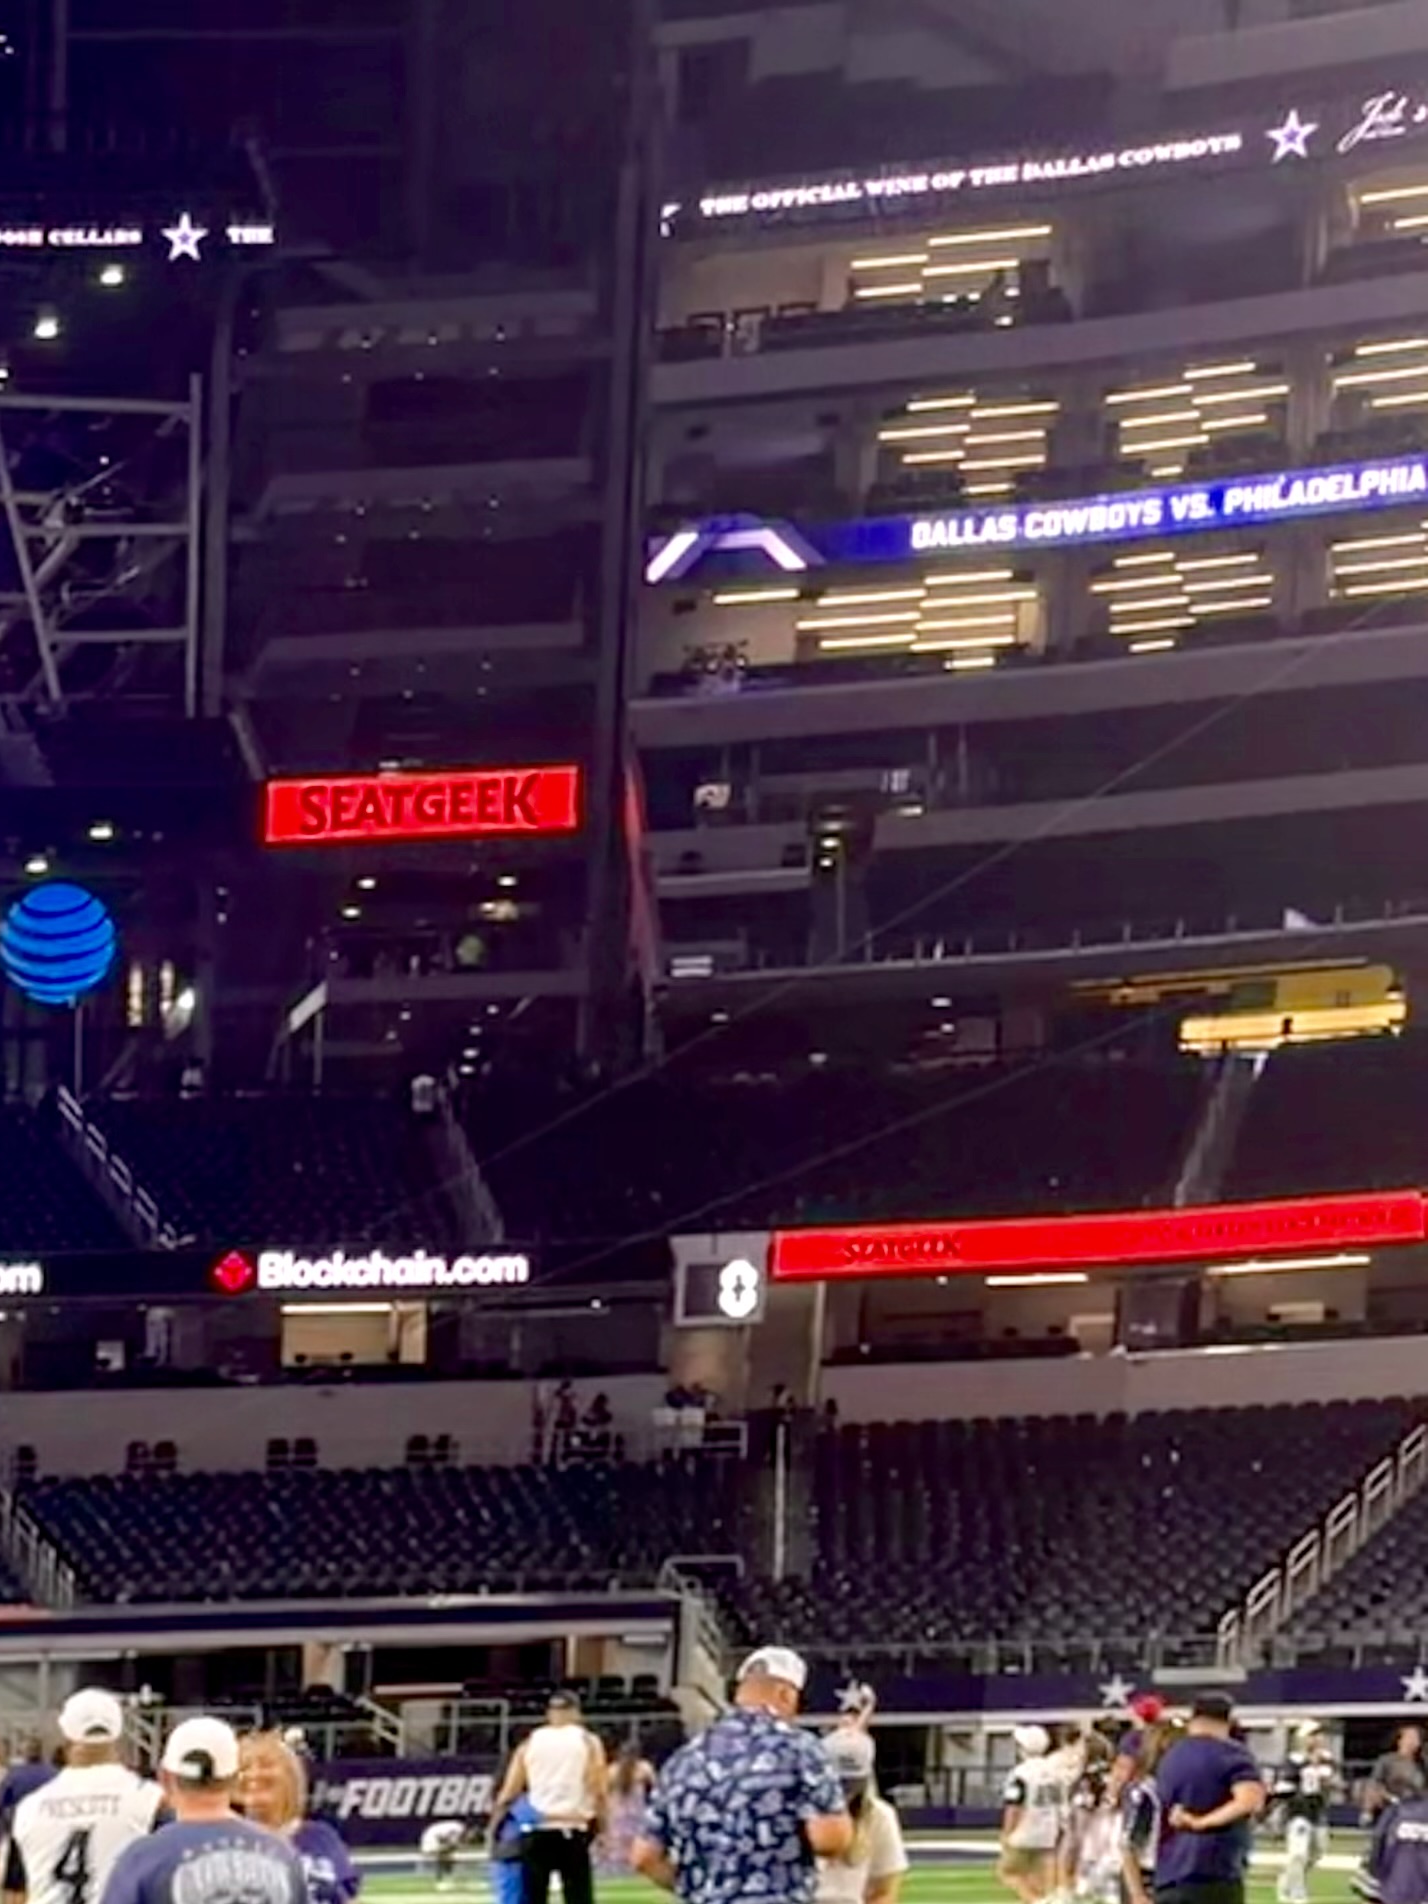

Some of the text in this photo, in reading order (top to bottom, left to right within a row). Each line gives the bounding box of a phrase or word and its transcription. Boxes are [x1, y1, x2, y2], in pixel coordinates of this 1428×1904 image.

[700, 132, 1242, 216] THE OFFICIAL WINE OF THE DALLAS COWBOYS
[48, 229, 143, 246] CELLARS
[226, 225, 275, 244] THE
[910, 463, 1428, 550] DALLAS COWBOYS VS. PHILADELPHIA
[299, 773, 540, 835] SEATGEEK
[257, 1251, 529, 1289] Blockchain.com
